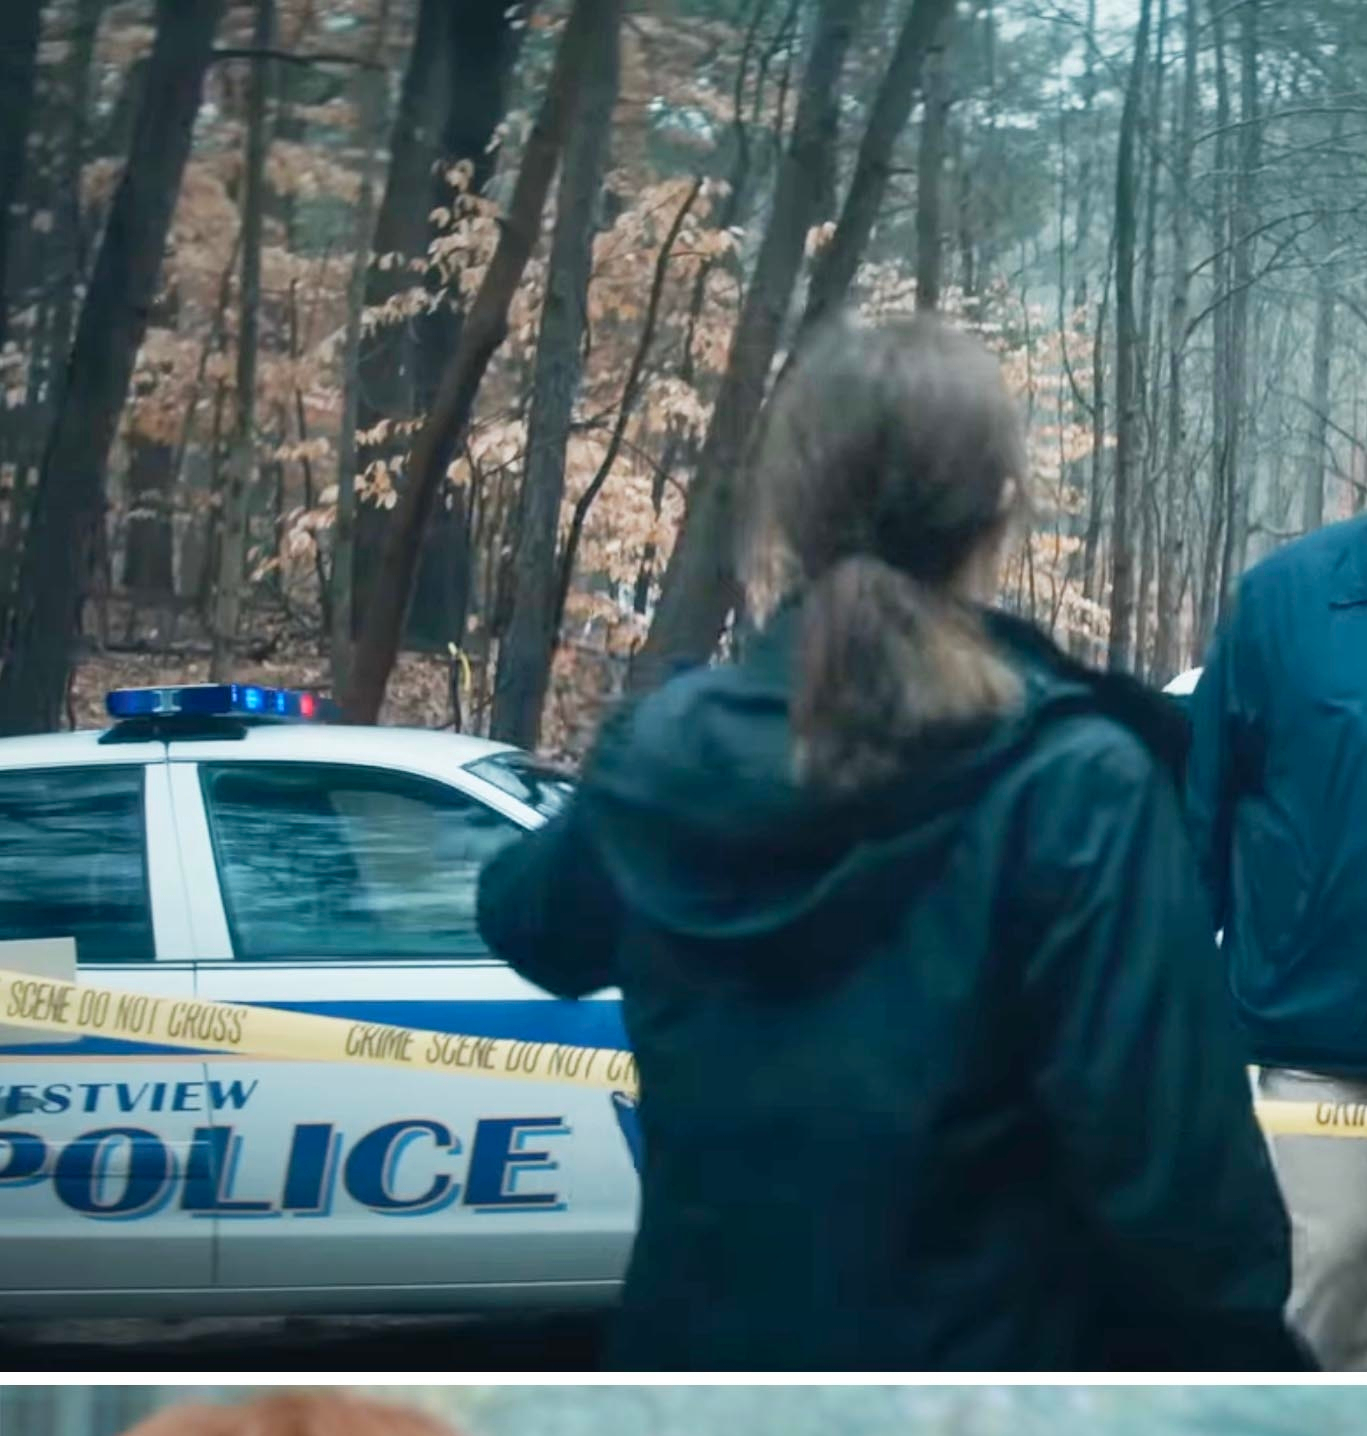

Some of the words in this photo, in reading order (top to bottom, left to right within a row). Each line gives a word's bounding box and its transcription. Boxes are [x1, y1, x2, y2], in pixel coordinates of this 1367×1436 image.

[7, 980, 75, 1024] SCENE
[76, 989, 112, 1029] DO
[113, 995, 168, 1036] NOT
[167, 1001, 248, 1044] CROSS
[345, 1023, 413, 1062] CRIME
[425, 1033, 500, 1070] SCENE
[505, 1040, 543, 1074] DO
[547, 1044, 596, 1078] NOT
[0, 1079, 259, 1114] ESTVIEW
